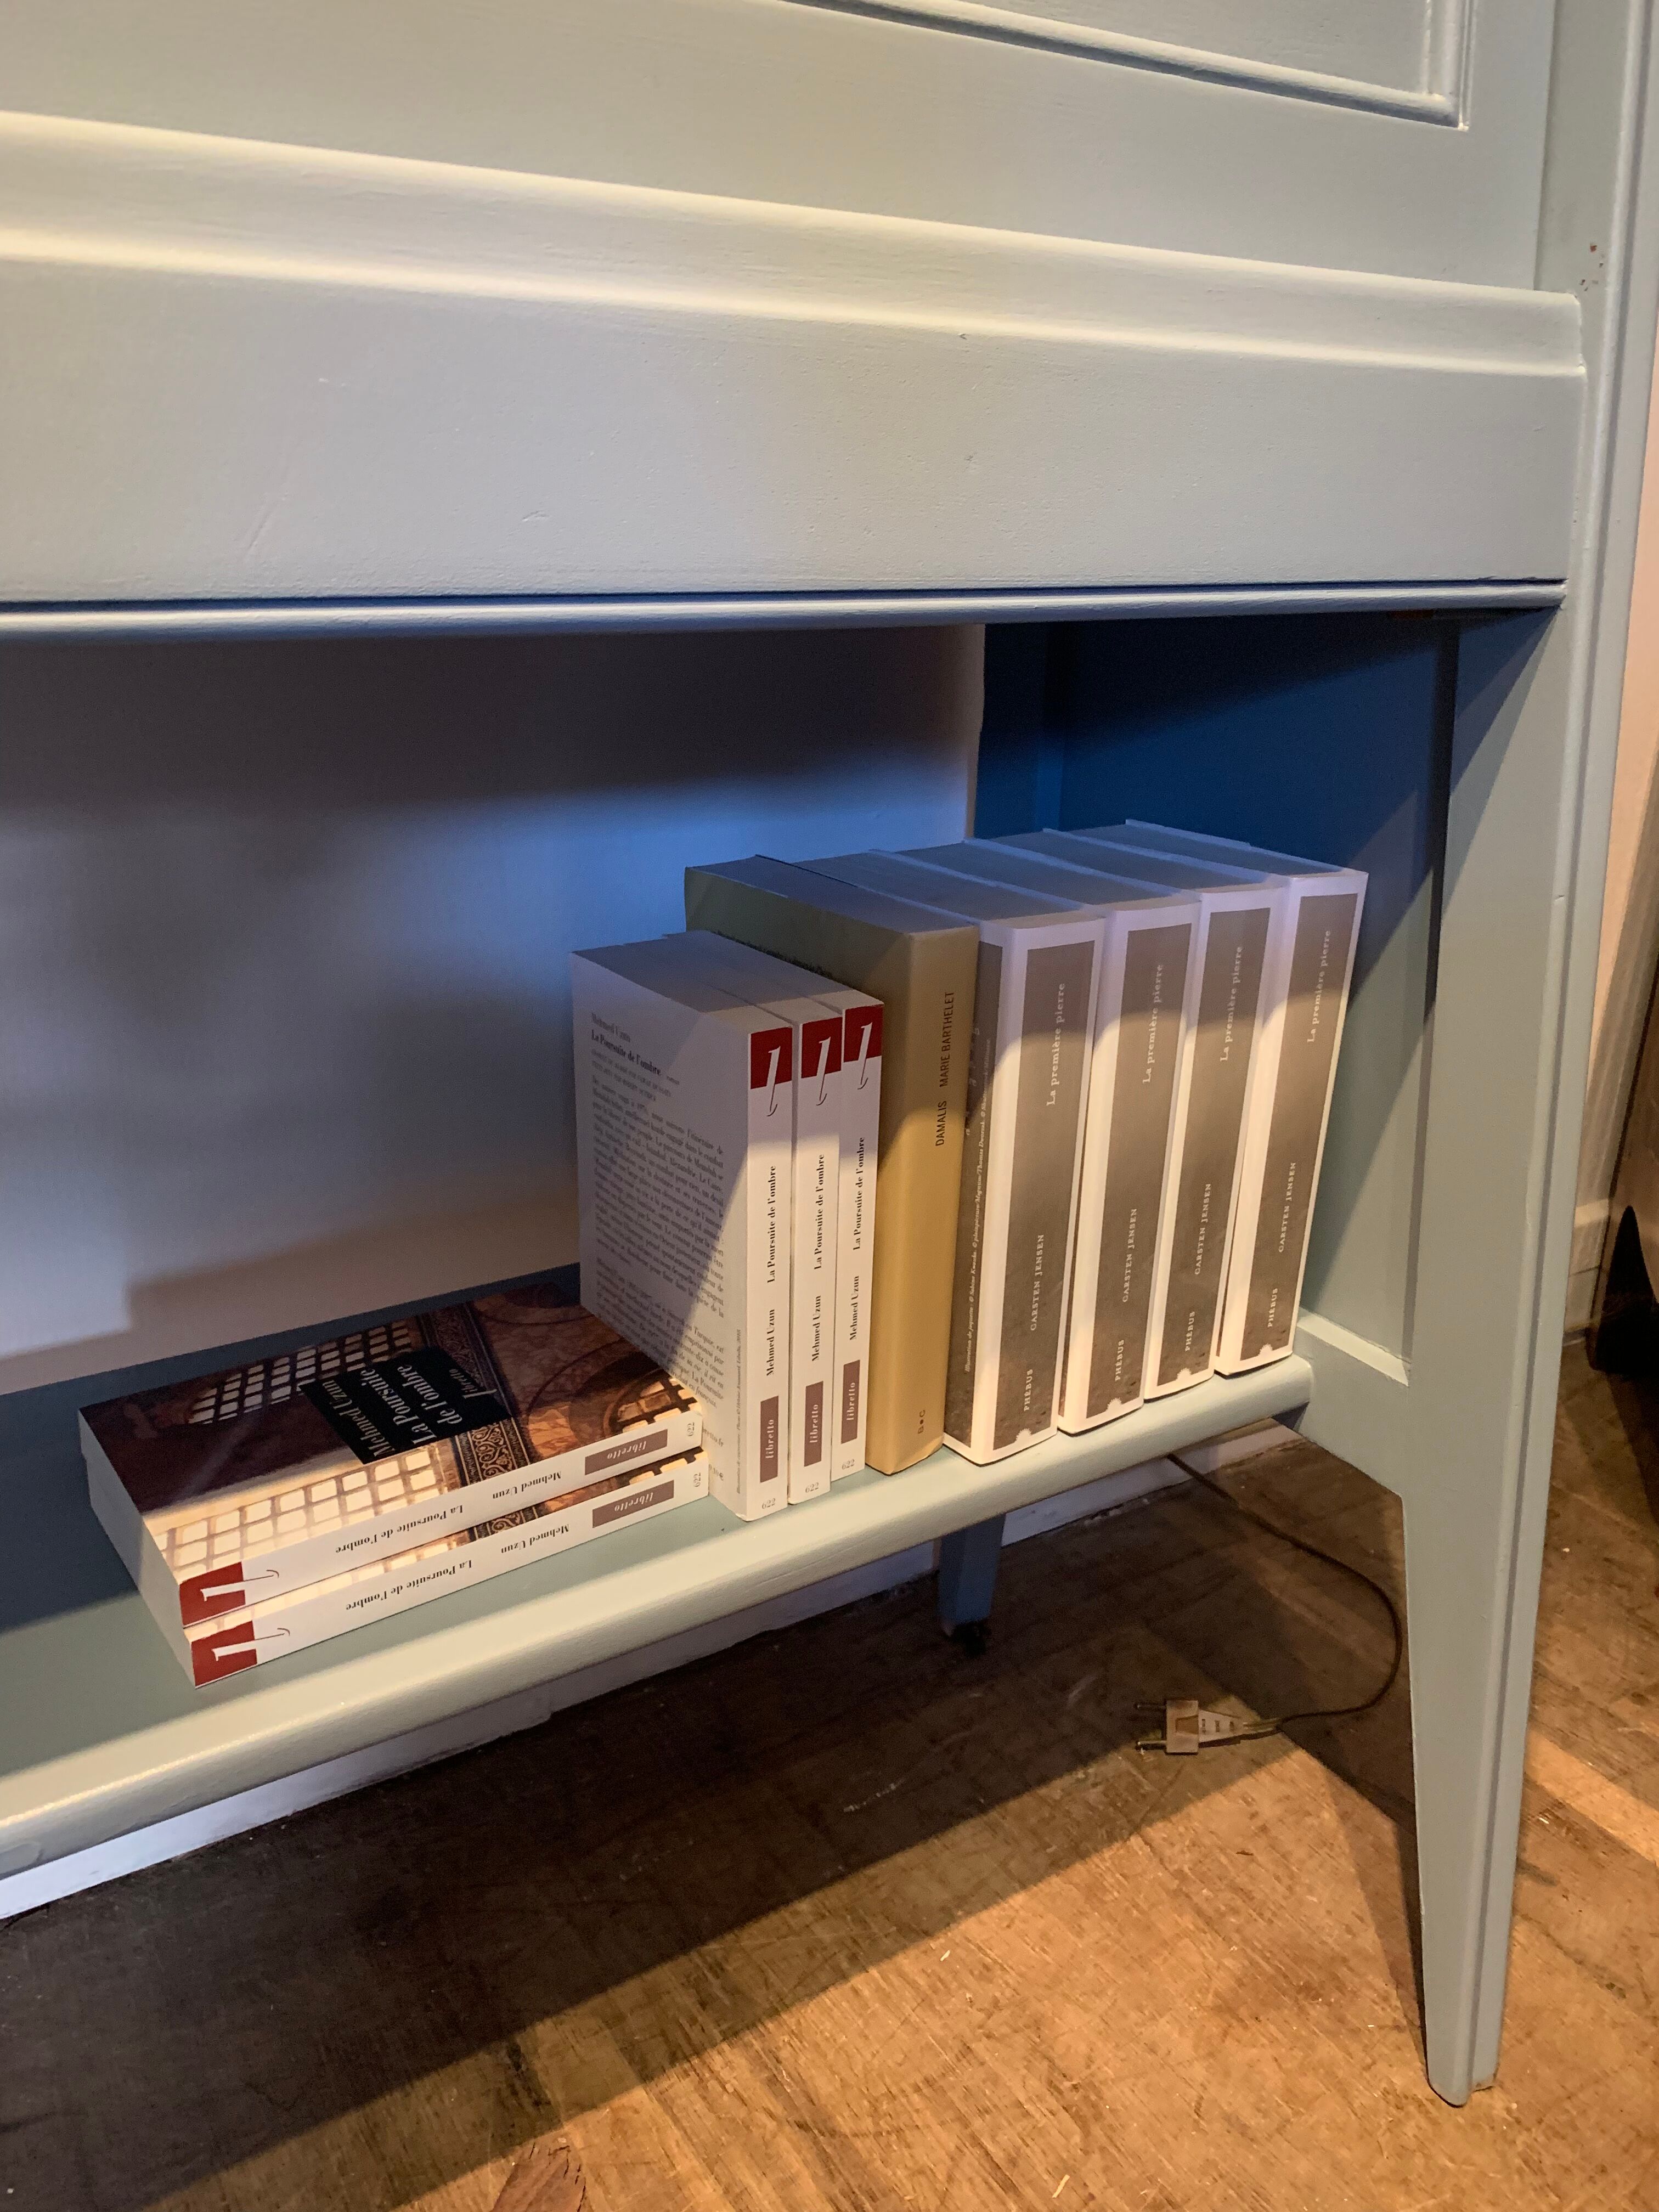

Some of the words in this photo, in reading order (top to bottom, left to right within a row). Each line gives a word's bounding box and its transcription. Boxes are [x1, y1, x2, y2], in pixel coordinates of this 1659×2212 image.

[1233, 946, 1243, 985] pierre
[1153, 964, 1164, 1003] pierre
[1307, 1028, 1317, 1043] La
[1312, 970, 1325, 1025] première
[1321, 930, 1331, 967] pierre
[1056, 983, 1065, 1023] pierre
[941, 992, 955, 1051] BARTHELET
[1224, 988, 1237, 1043] première
[1147, 1007, 1159, 1064] première
[591, 1029, 599, 1043] La
[600, 1034, 626, 1058] Poursuite
[628, 1050, 635, 1062] de
[636, 1054, 661, 1075] l'ombre
[1050, 1028, 1062, 1086] première
[1220, 1046, 1229, 1062] La
[939, 1054, 951, 1088] MARIE
[1143, 1068, 1152, 1084] La
[1046, 1090, 1056, 1106] La
[935, 1101, 947, 1147] DAMALIS
[856, 1137, 865, 1174] l'ombre
[768, 1165, 776, 1204] l'ombre
[815, 1154, 825, 1192] l'ombre
[855, 1176, 863, 1188] de
[768, 1206, 776, 1218] de
[815, 1194, 823, 1206] de
[1278, 1205, 1290, 1252] CARSTEN
[1286, 1162, 1296, 1201] JENSEN
[854, 1190, 863, 1236] Poursuite
[814, 1209, 823, 1255] Poursuite
[1194, 1227, 1206, 1276] CARSTEN
[1201, 1183, 1211, 1223] JENSEN
[767, 1221, 776, 1268] Poursuite
[853, 1238, 861, 1250] La
[1034, 1234, 1045, 1276] JENSEN
[1122, 1254, 1132, 1302] CARSTEN
[1127, 1209, 1137, 1249] JENSEN
[814, 1256, 822, 1270] La
[718, 1282, 723, 1294] de
[767, 1269, 775, 1283] La
[851, 1276, 859, 1300] Uzun
[710, 1301, 716, 1313] de
[719, 1307, 723, 1318] la
[813, 1295, 821, 1321] Uzun
[1030, 1280, 1041, 1331] CARSTEN
[766, 1309, 775, 1334] Uzun
[850, 1302, 858, 1341] Mehmed
[694, 1325, 715, 1351] Turquie,
[812, 1322, 820, 1362] Mehmed
[714, 1354, 724, 1369] par
[766, 1336, 775, 1376] Mehmed
[692, 1372, 698, 1382] La
[709, 1363, 724, 1378] cause
[322, 1379, 353, 1410] Uzun
[397, 1364, 448, 1410] l'ombre
[448, 1368, 497, 1399] libretto
[718, 1380, 723, 1389] en
[360, 1368, 420, 1426] Poursuite
[846, 1382, 856, 1421] libretto
[437, 1407, 462, 1425] de
[810, 1403, 819, 1443] libretto
[338, 1406, 396, 1457] Mehmed
[411, 1421, 438, 1444] La
[687, 1421, 695, 1437] 622
[765, 1419, 775, 1459] libretto
[607, 1440, 647, 1459] libretto
[842, 1459, 855, 1470] 622
[521, 1470, 562, 1493] Mehmed
[693, 1472, 702, 1487] 622
[805, 1482, 820, 1493] 622
[493, 1486, 518, 1499] Uzun
[614, 1491, 654, 1513] libretto
[761, 1498, 776, 1509] 622
[397, 1510, 447, 1532] Poursuite
[450, 1505, 463, 1514] La
[335, 1533, 377, 1554] l'ombre
[381, 1528, 393, 1538] de
[529, 1523, 570, 1547] Mehmed
[500, 1541, 527, 1554] Uzun
[459, 1560, 472, 1569] La
[406, 1565, 456, 1589] Poursuite
[345, 1590, 388, 1610] l'ombre
[391, 1584, 403, 1595] de
